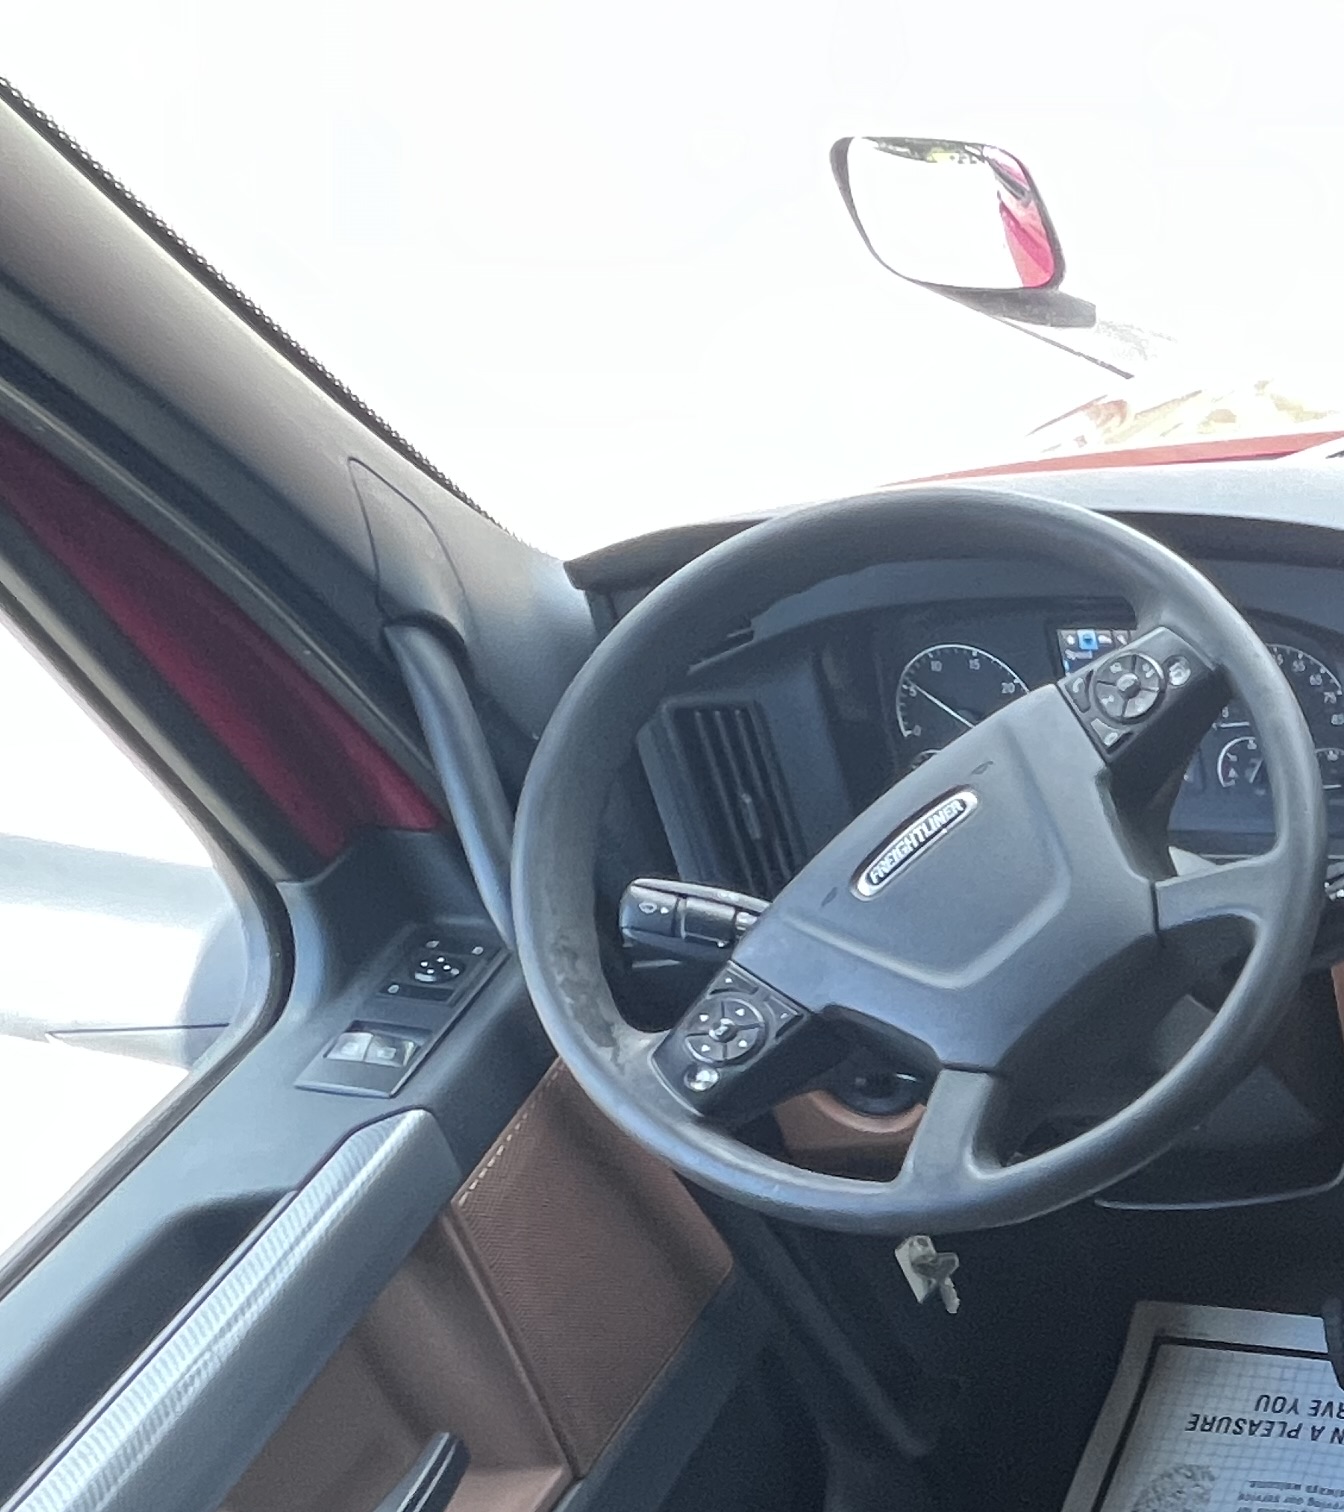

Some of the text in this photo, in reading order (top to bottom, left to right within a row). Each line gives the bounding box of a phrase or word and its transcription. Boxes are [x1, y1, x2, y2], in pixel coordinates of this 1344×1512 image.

[930, 660, 943, 673] 10
[969, 658, 981, 671] 15
[1001, 681, 1016, 695] 20
[868, 798, 965, 885] FREIGHTLINER
[1253, 1394, 1300, 1415] YOU
[1184, 1413, 1303, 1439] PLEASURE
[1310, 1424, 1326, 1441] A
[1237, 1491, 1281, 1503] service
[1281, 1496, 1304, 1506] our
